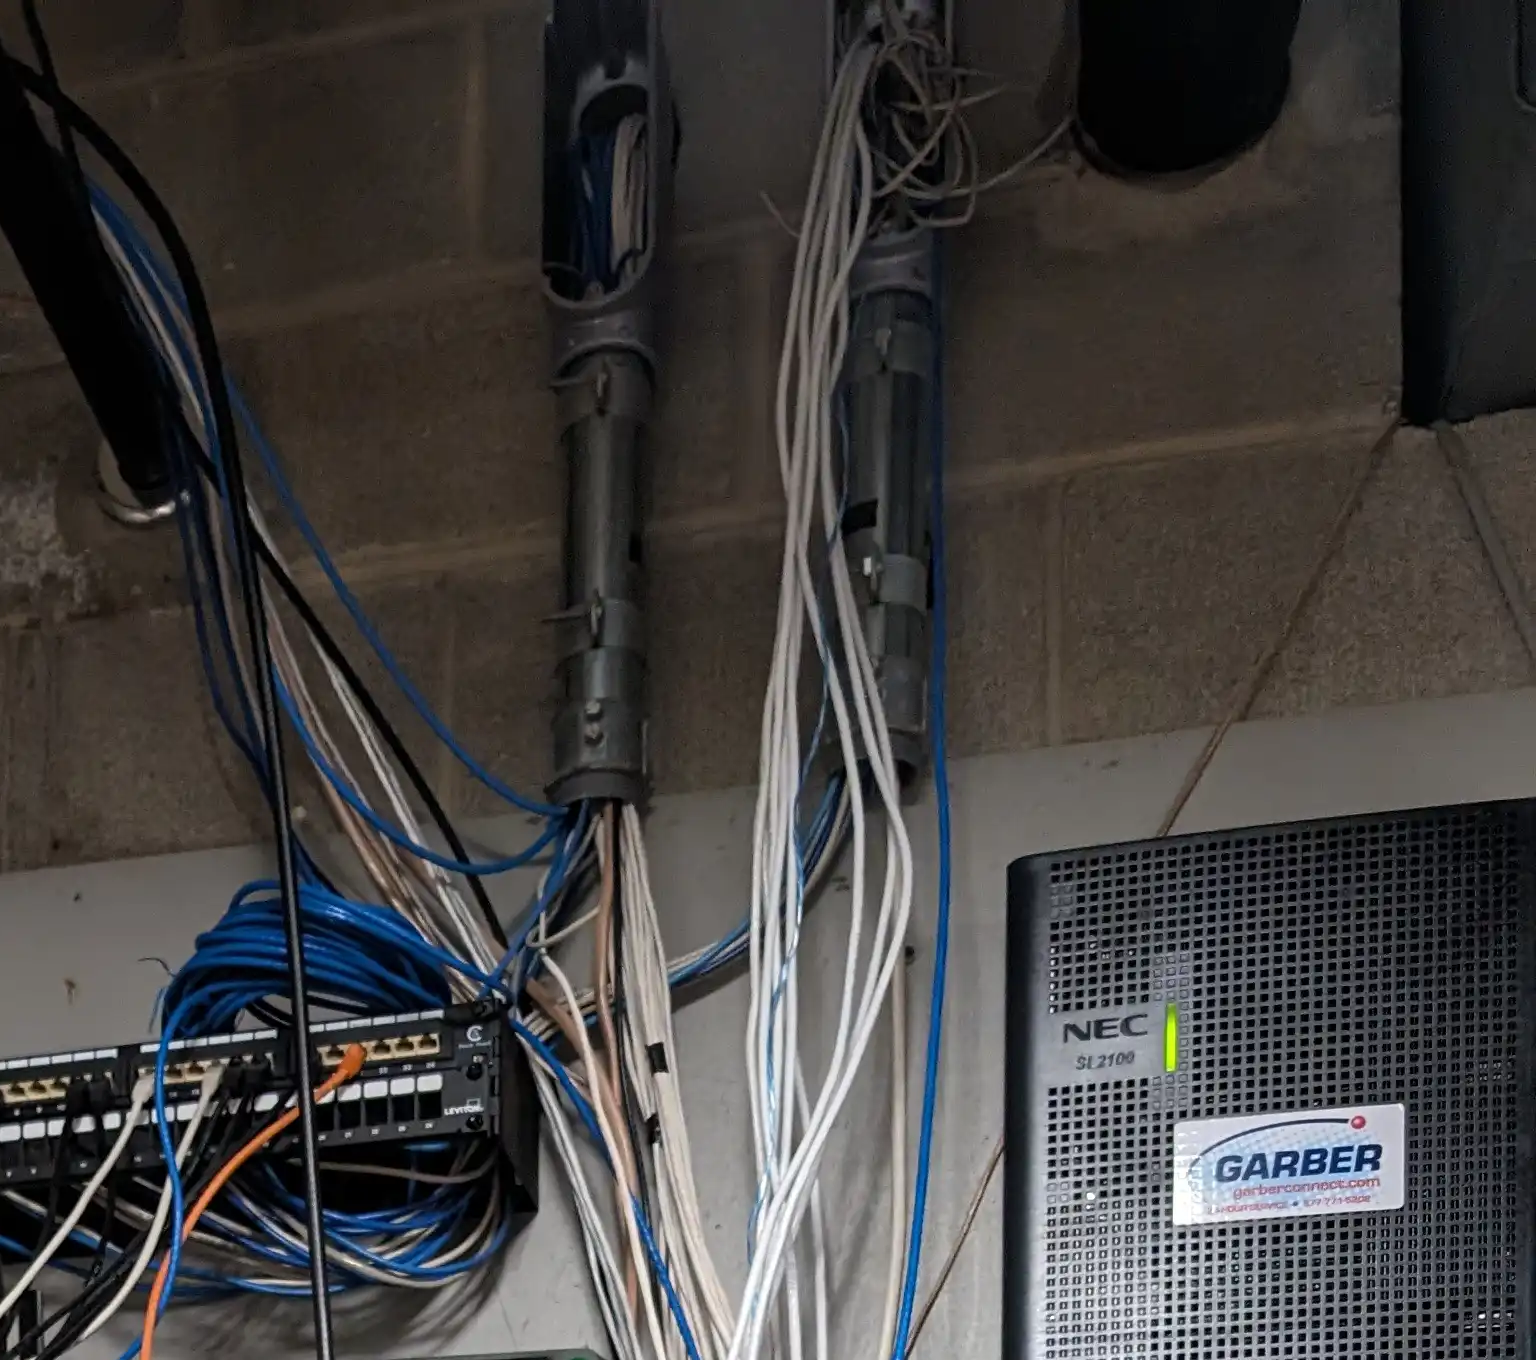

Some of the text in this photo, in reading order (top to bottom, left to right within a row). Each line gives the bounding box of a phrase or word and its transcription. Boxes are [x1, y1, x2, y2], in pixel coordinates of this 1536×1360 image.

[1062, 1013, 1149, 1044] NEC
[1075, 1050, 1135, 1072] SL2100
[1214, 1143, 1383, 1183] GARBER
[1232, 1177, 1381, 1200] garberconnect.com
